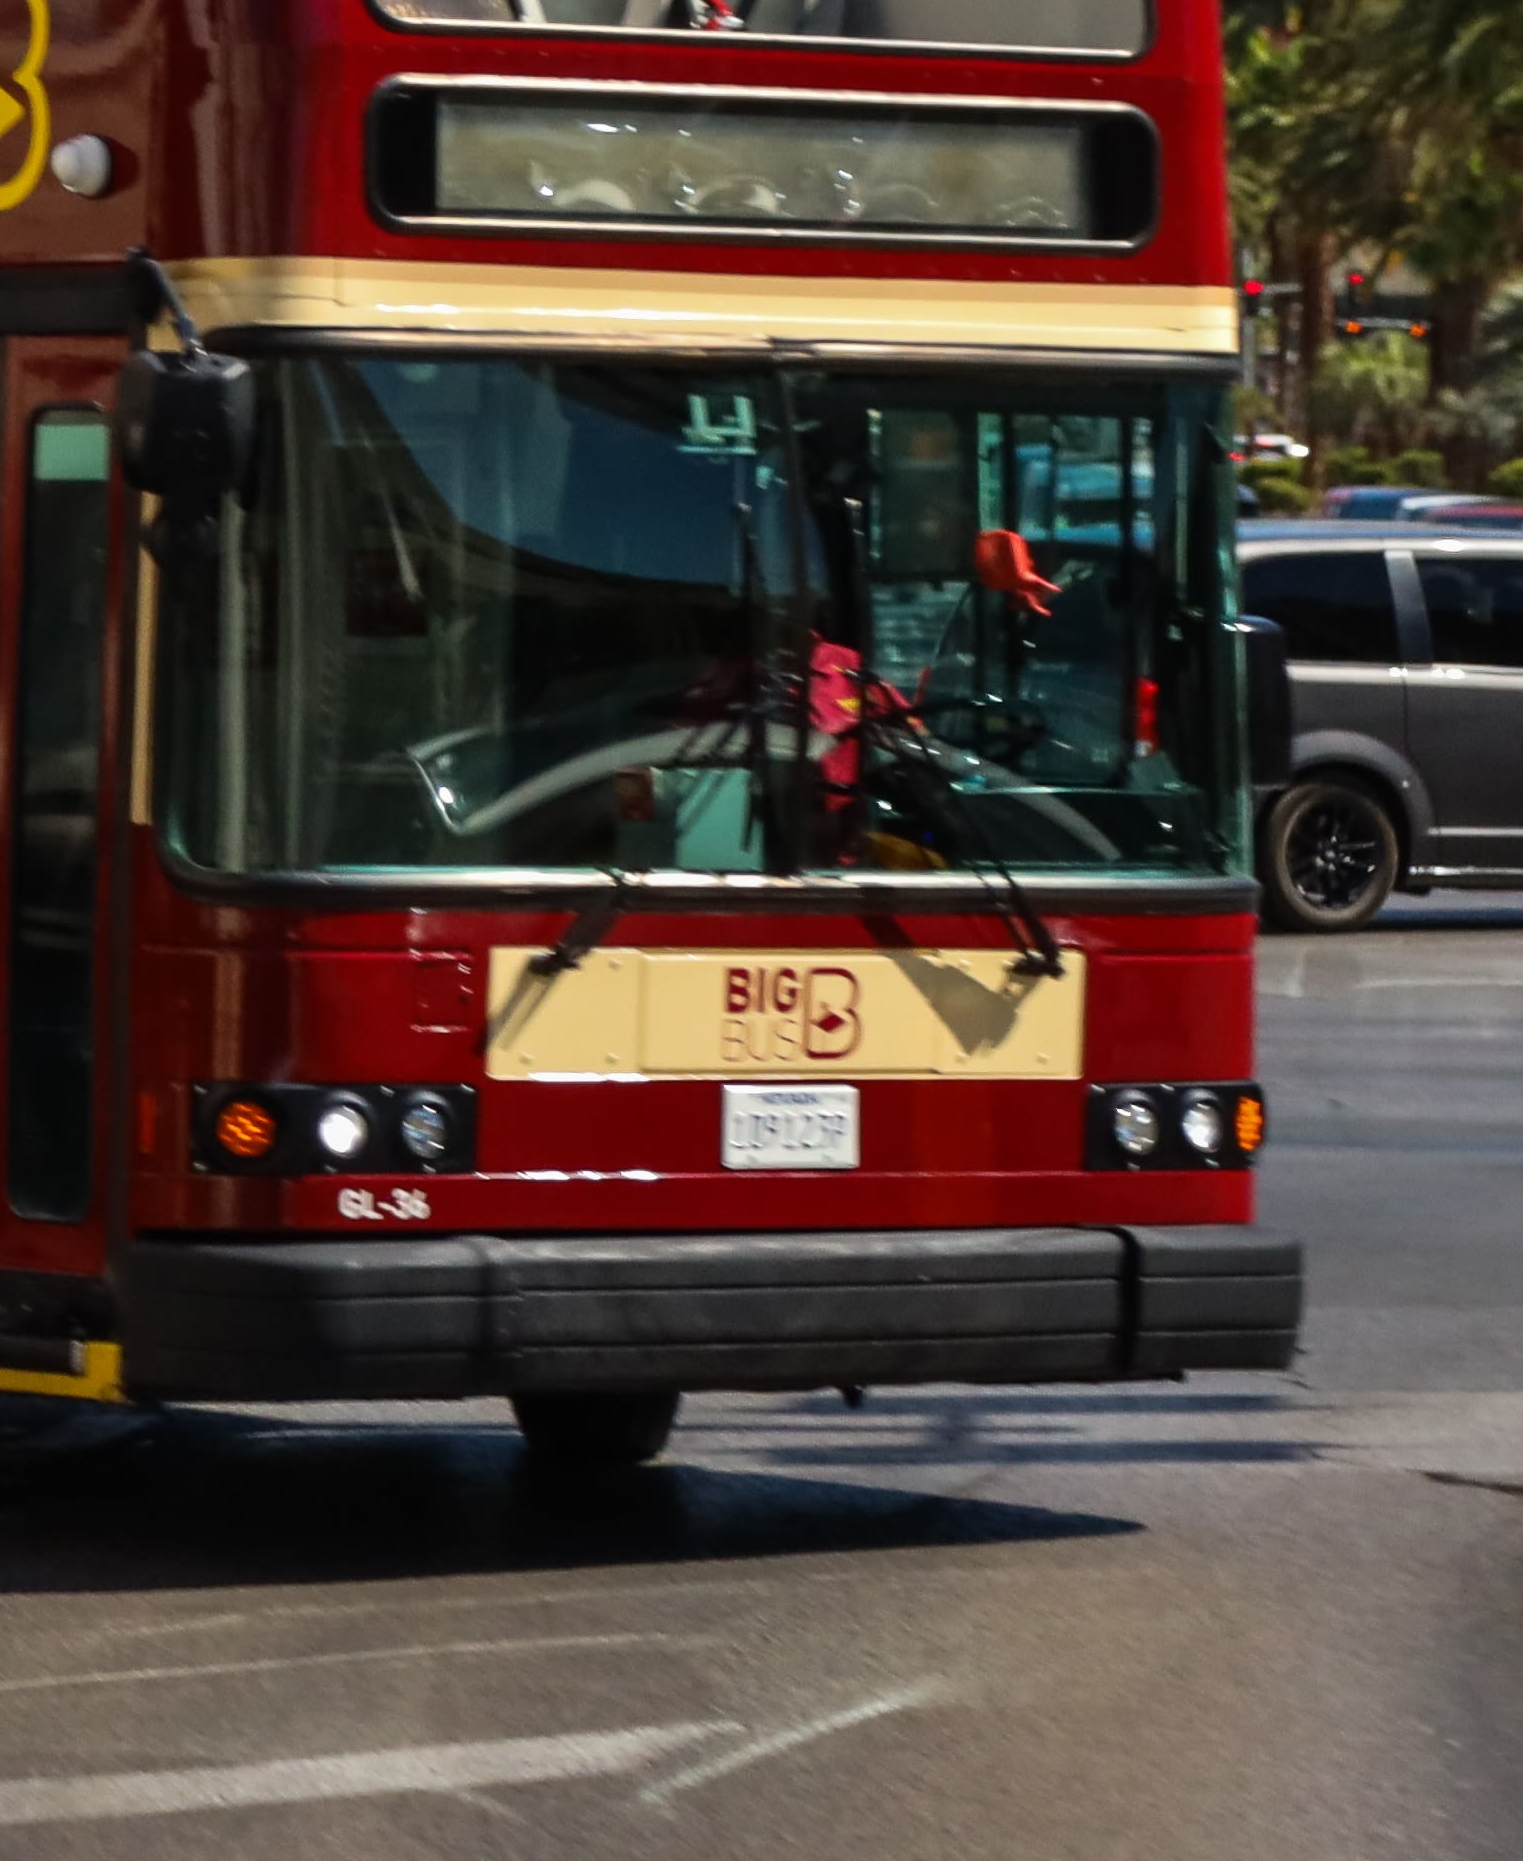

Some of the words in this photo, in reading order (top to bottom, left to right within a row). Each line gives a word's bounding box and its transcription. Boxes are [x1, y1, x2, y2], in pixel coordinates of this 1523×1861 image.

[725, 967, 800, 1014] BIG
[721, 1018, 800, 1063] BUS
[338, 1187, 432, 1220] GL-36
